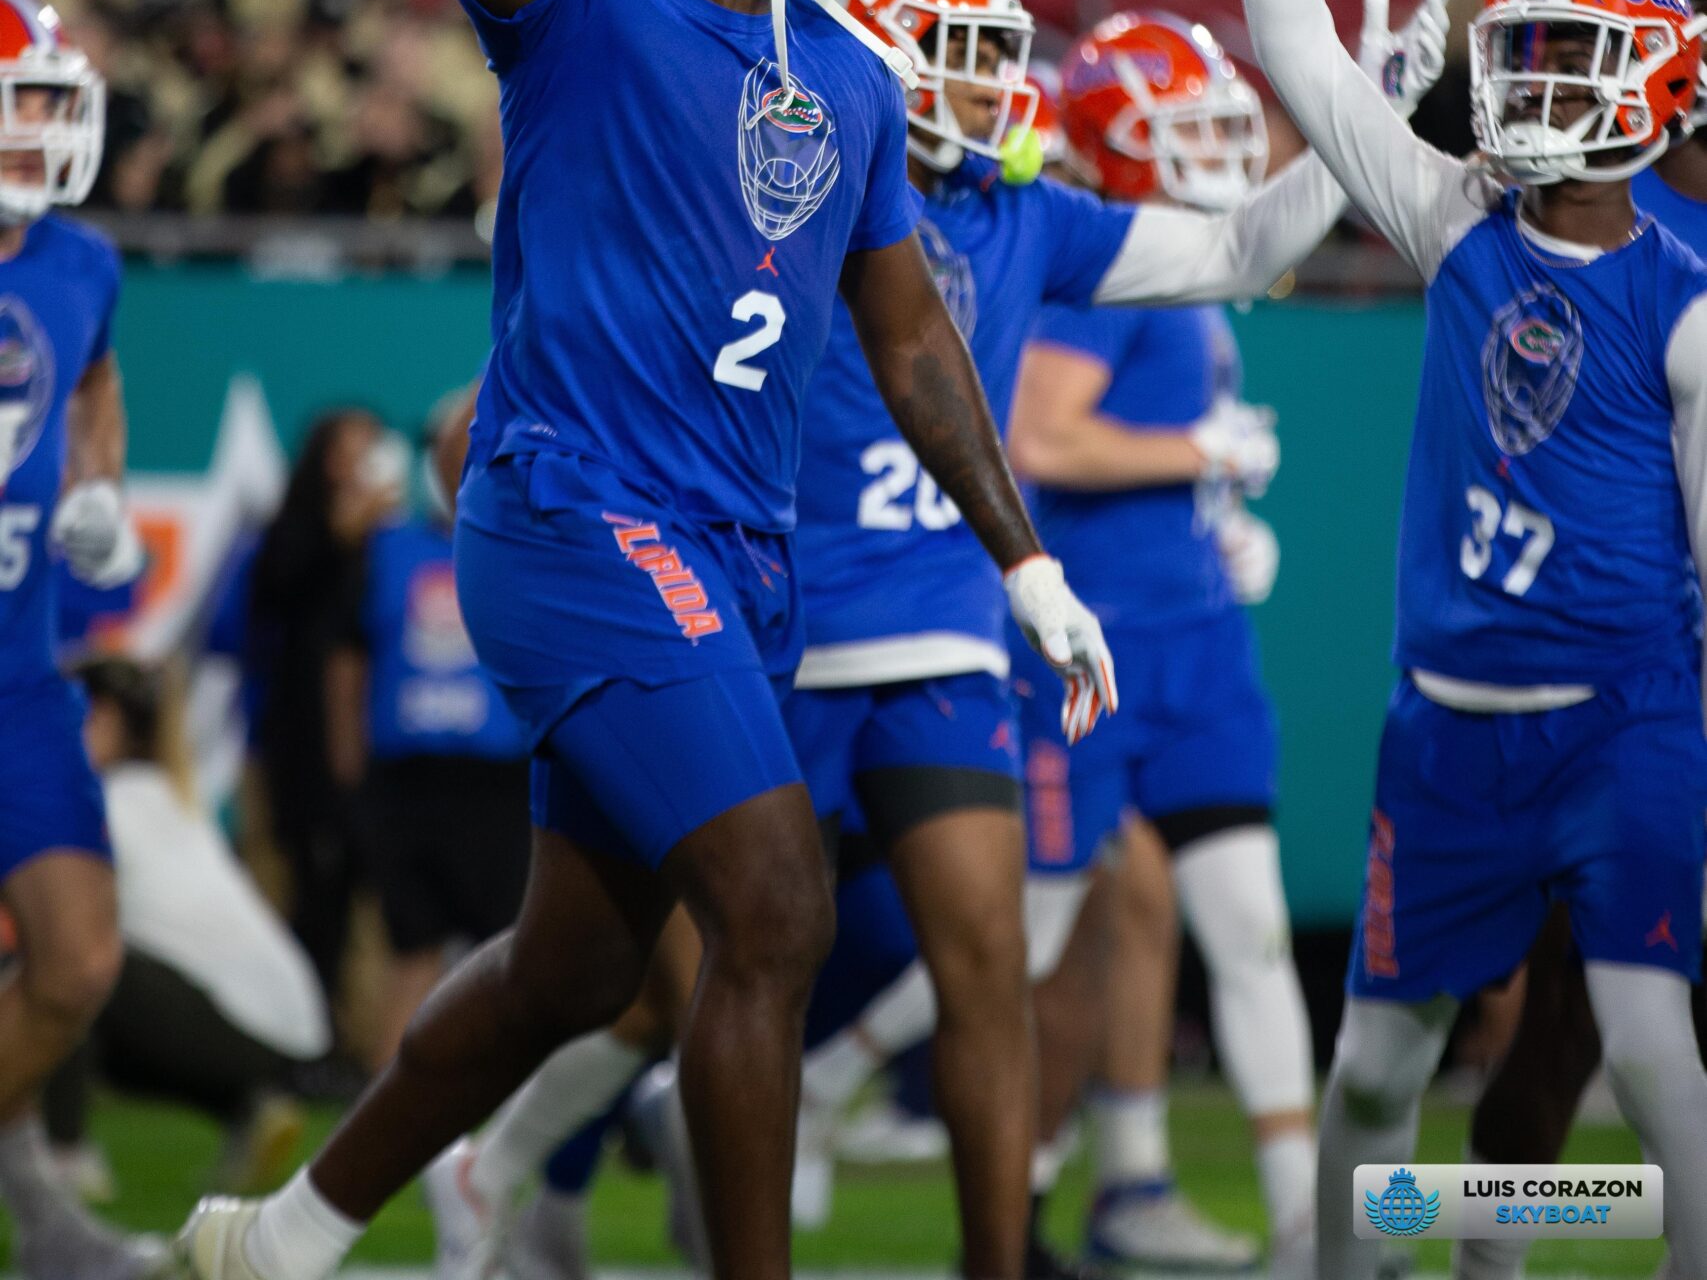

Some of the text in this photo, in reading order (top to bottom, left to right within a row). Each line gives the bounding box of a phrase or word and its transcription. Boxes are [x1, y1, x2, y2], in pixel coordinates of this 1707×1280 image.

[713, 289, 787, 392] 2
[601, 509, 724, 647] LORIDA
[1460, 484, 1556, 597] 37
